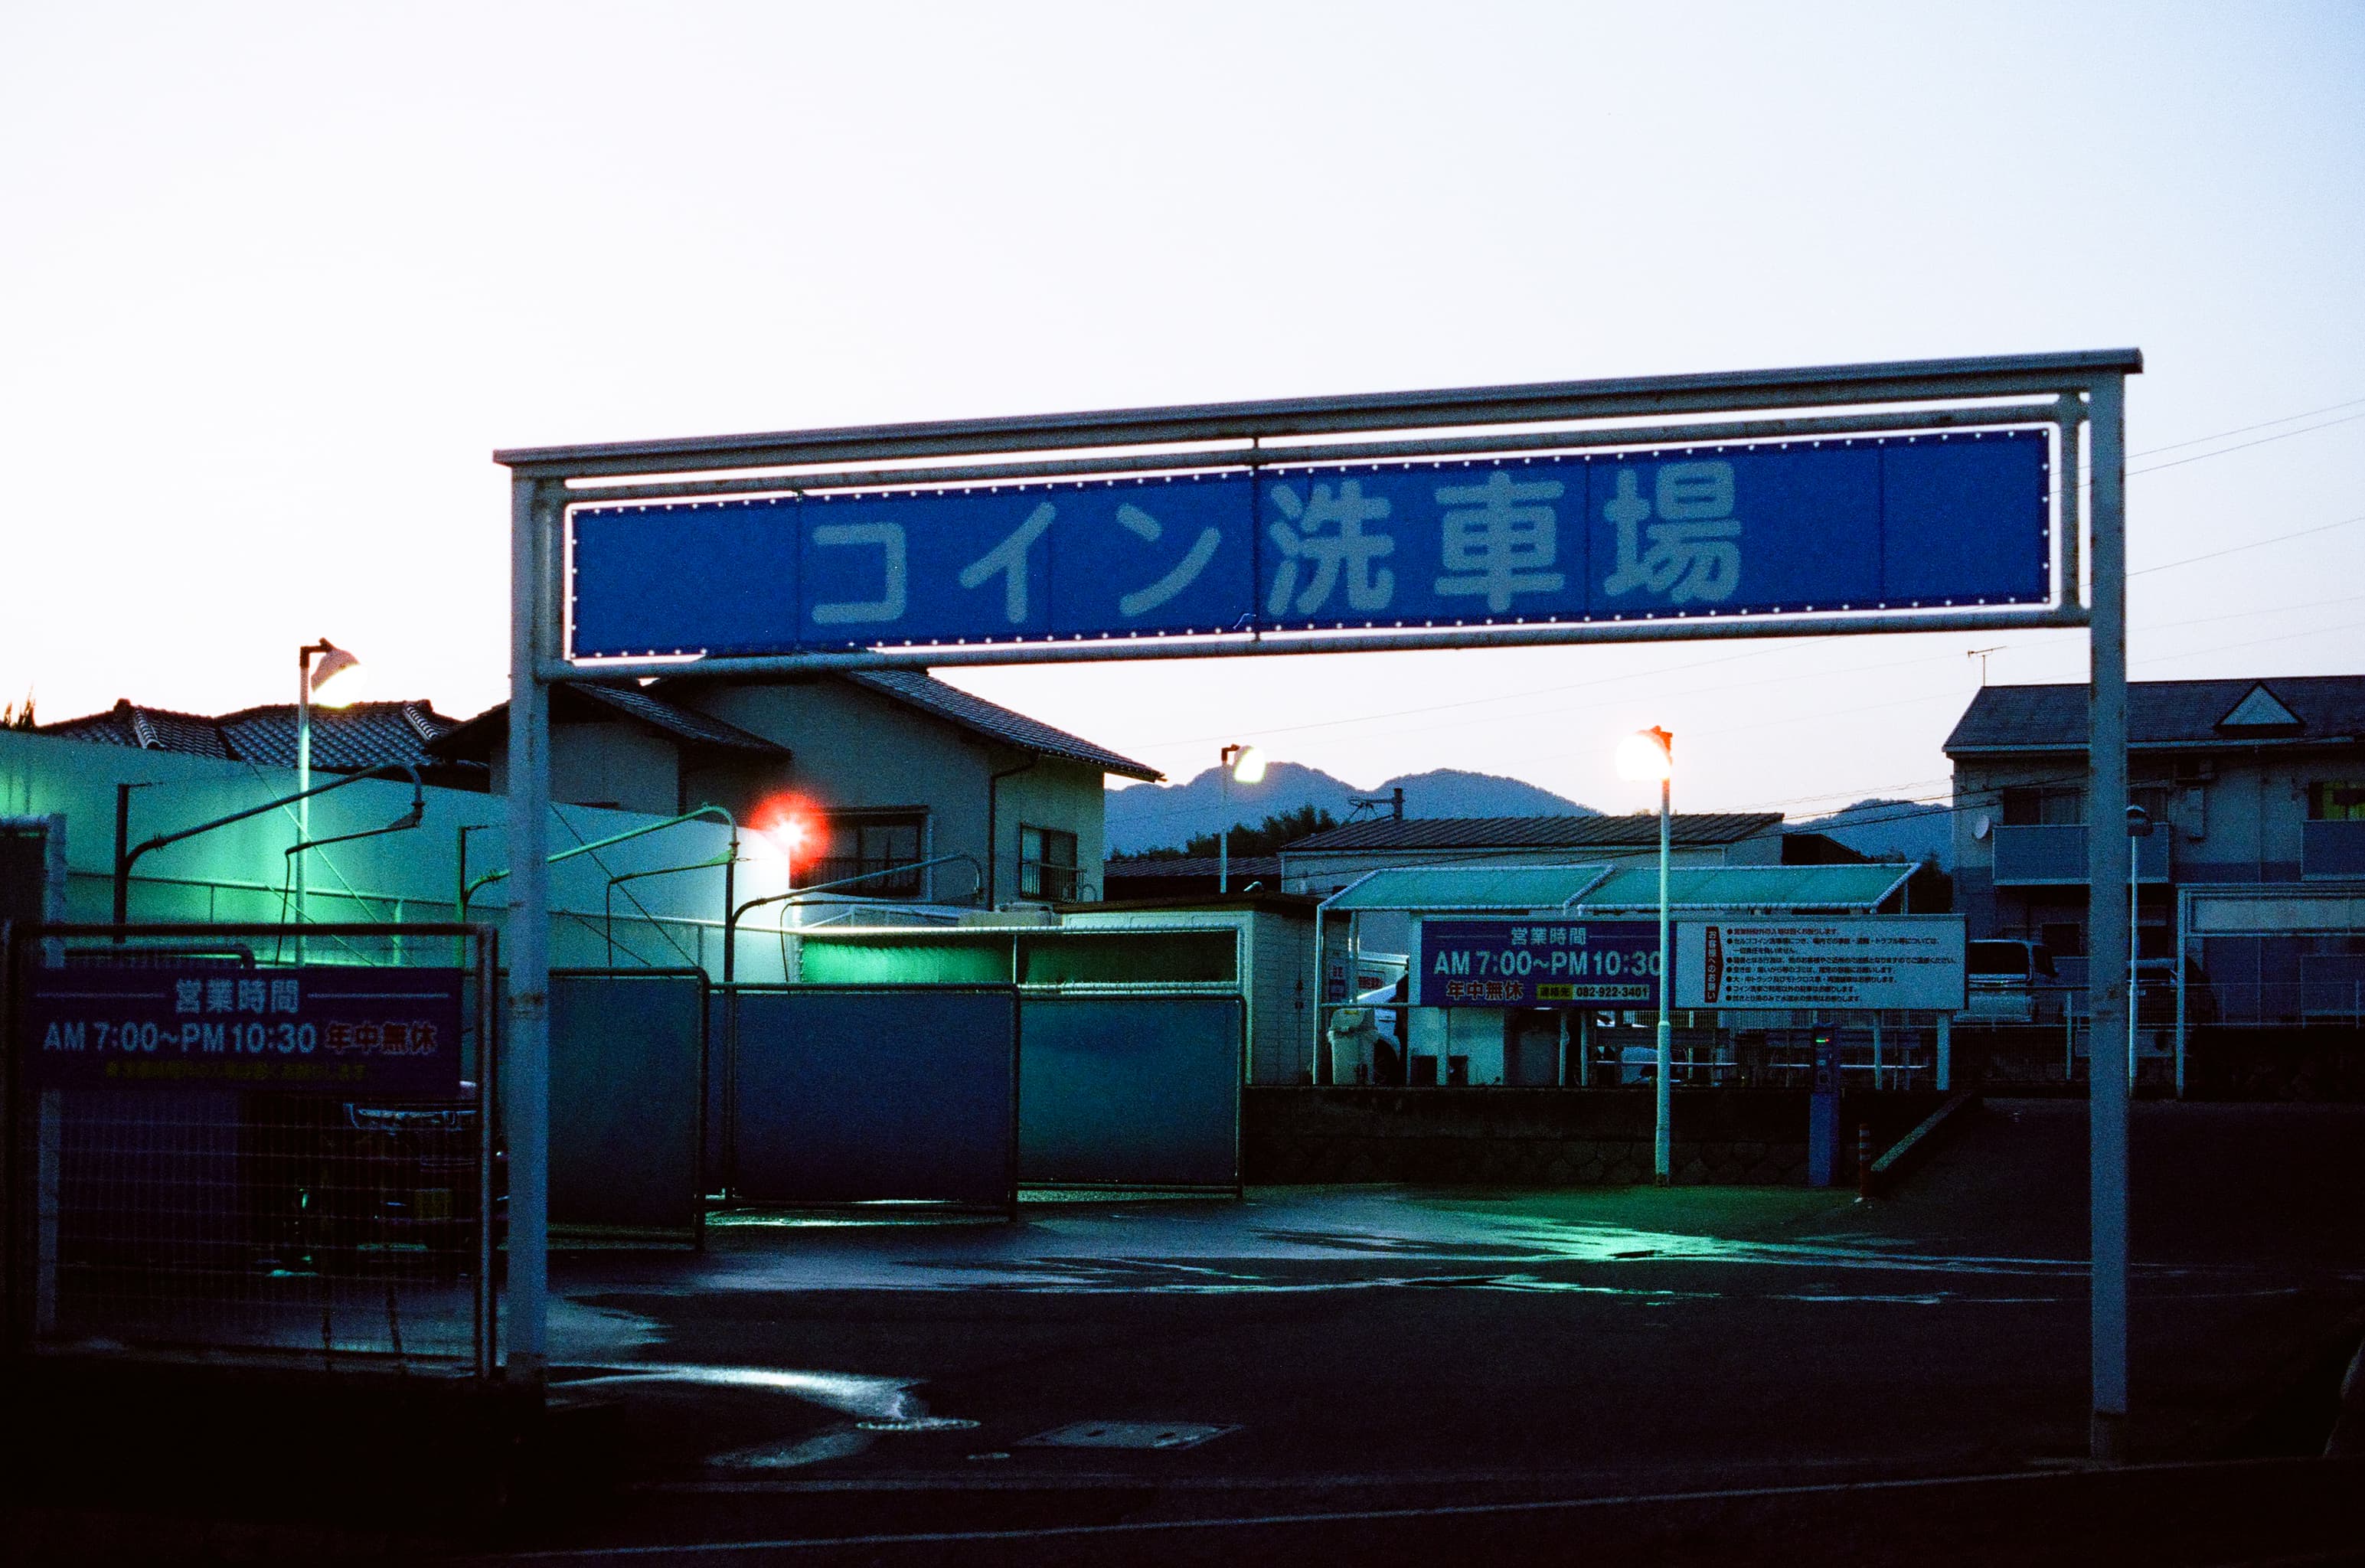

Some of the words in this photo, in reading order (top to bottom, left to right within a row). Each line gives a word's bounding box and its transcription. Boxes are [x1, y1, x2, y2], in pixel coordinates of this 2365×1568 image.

[812, 460, 1743, 624] コイン洗車場
[1510, 926, 1586, 946] 営業時間
[1433, 950, 1471, 975] AM
[175, 979, 301, 1014] 営業時間
[1445, 981, 1524, 1001] 年中無休
[42, 1023, 87, 1052] AM
[232, 1022, 318, 1054] 10:30
[325, 1021, 439, 1055] 年中無休
